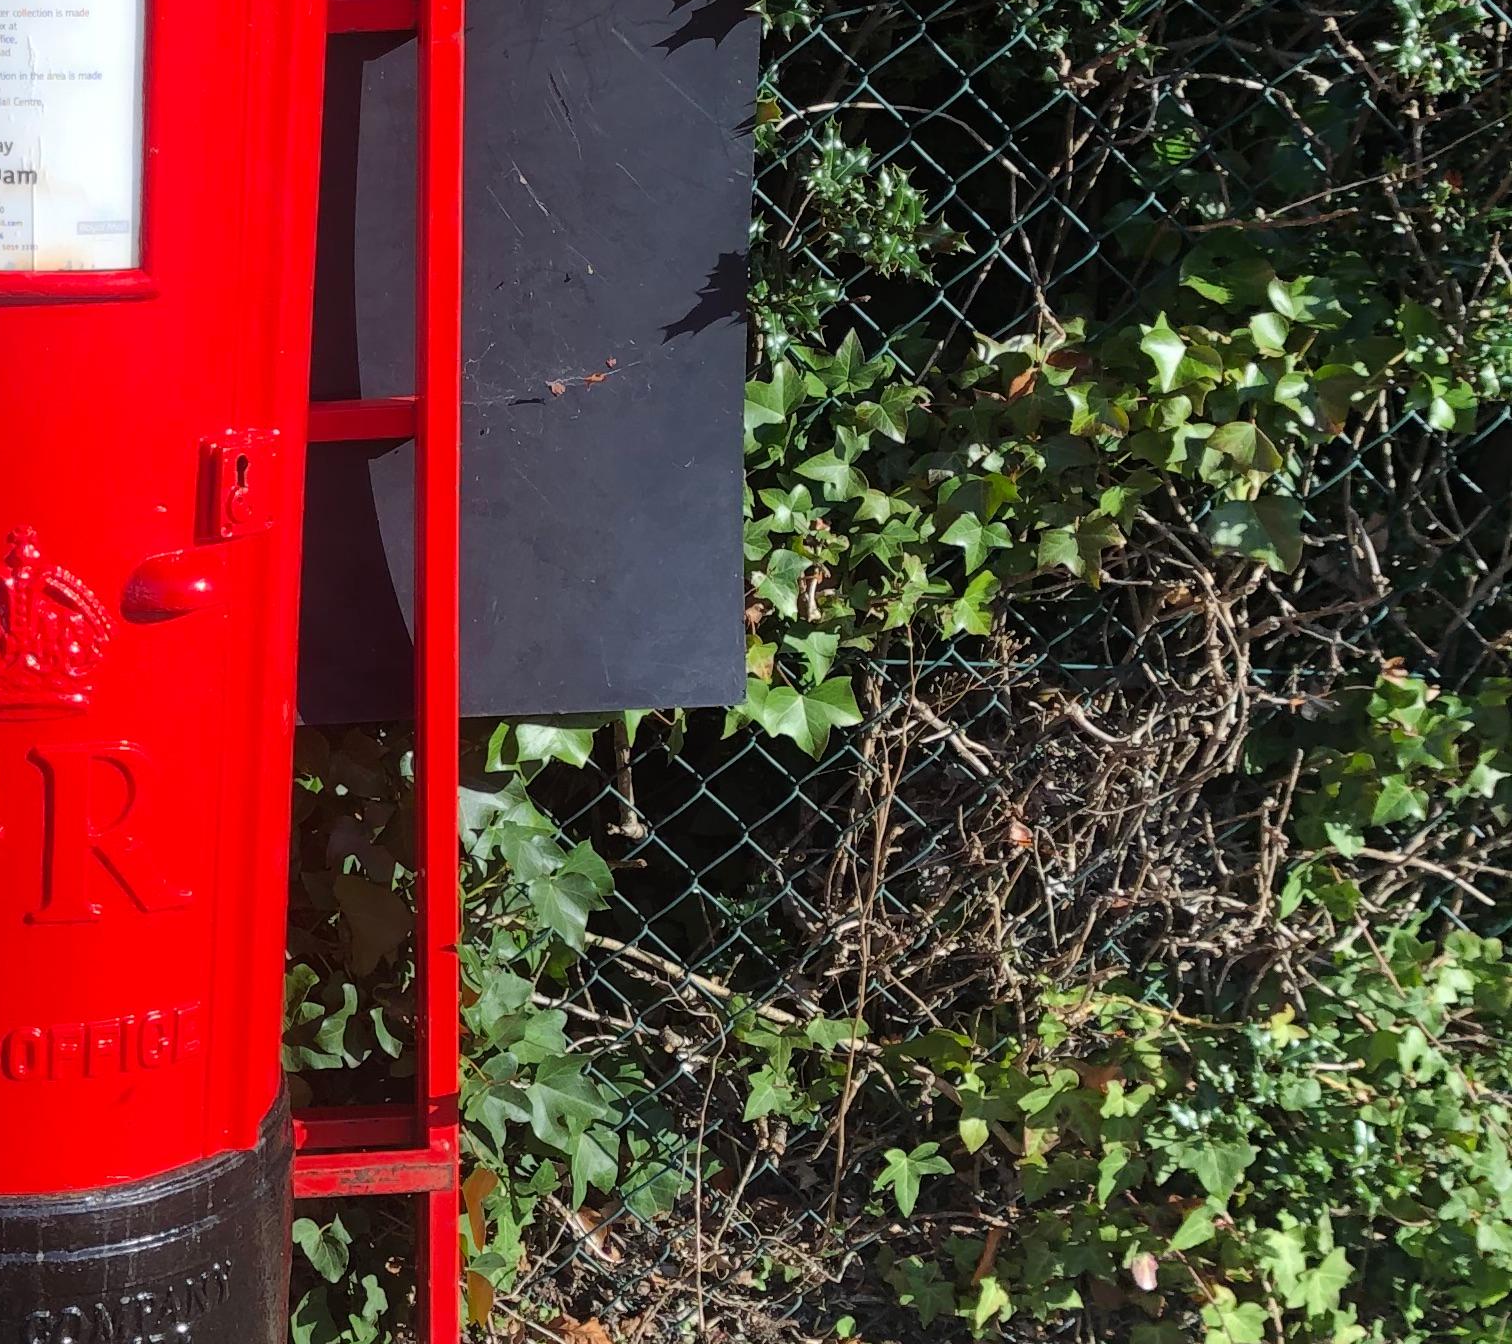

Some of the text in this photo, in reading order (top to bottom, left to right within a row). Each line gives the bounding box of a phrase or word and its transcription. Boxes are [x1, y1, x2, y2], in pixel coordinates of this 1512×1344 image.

[12, 8, 53, 18] collection
[55, 9, 63, 18] is
[65, 9, 90, 18] made
[8, 22, 18, 30] at
[20, 71, 27, 80] in
[30, 71, 44, 80] the
[68, 71, 75, 80] is
[78, 71, 103, 80] made
[0, 1000, 201, 1082] OFFICE
